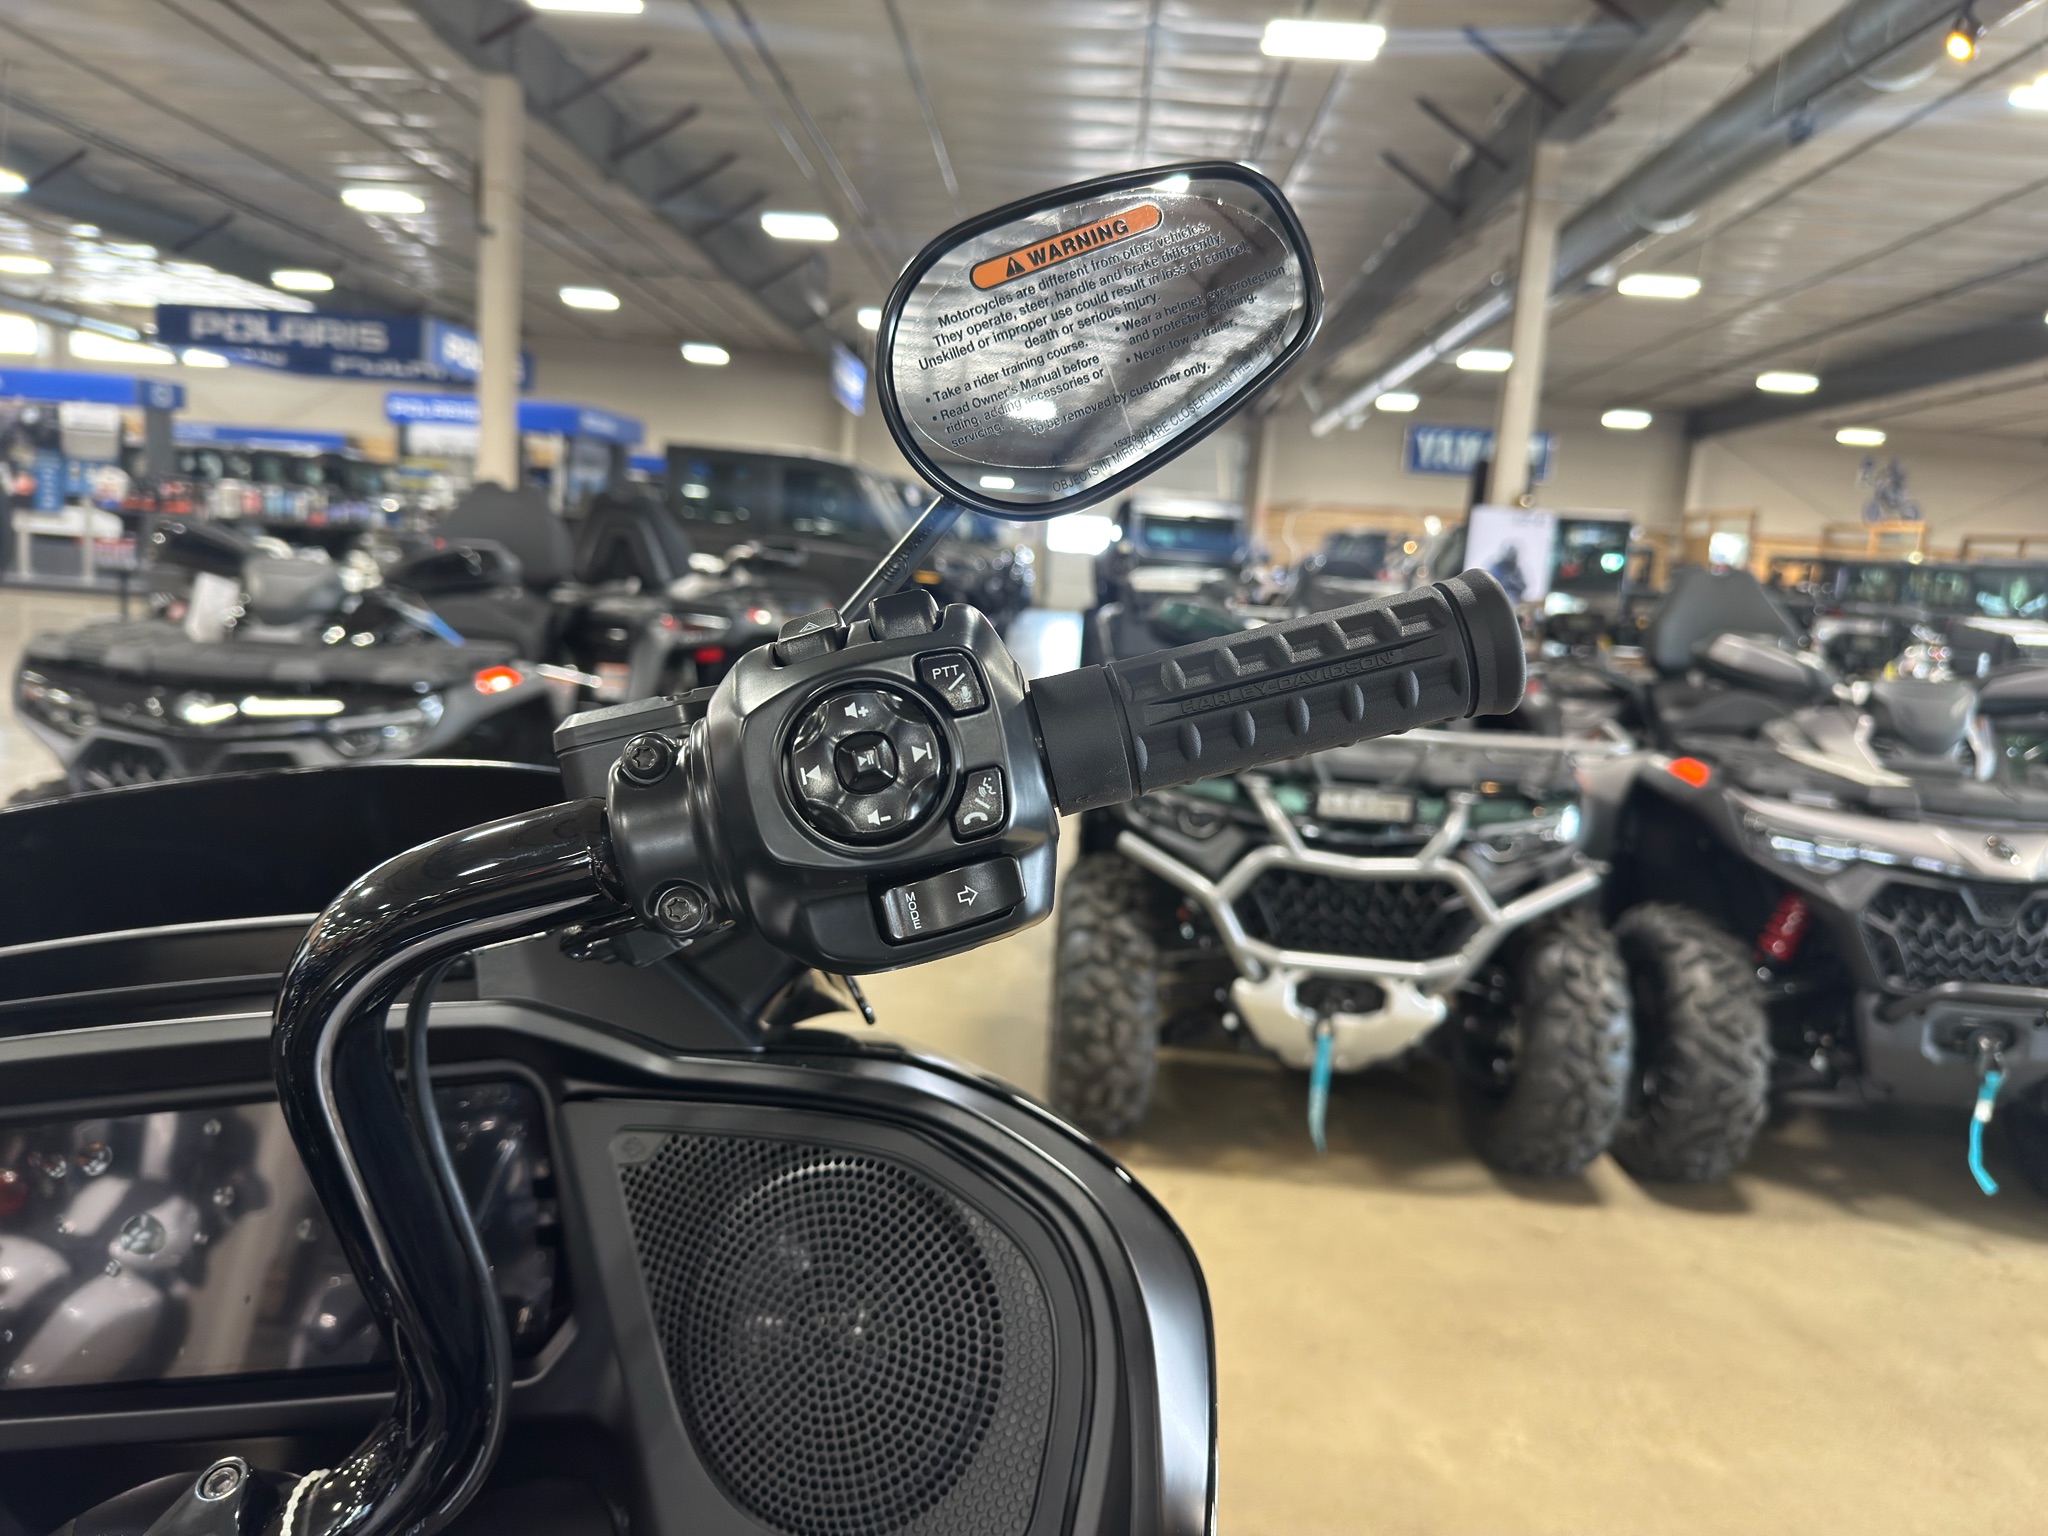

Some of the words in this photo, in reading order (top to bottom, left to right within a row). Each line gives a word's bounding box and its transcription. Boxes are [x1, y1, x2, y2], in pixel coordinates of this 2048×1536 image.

[1026, 219, 1129, 267] WARNING
[918, 338, 975, 371] Unskilled
[977, 337, 991, 350] or
[992, 314, 1048, 345] improper
[1051, 306, 1073, 321] use
[1075, 292, 1109, 312] could
[1111, 277, 1147, 297] result
[1149, 274, 1160, 286] in
[1161, 265, 1187, 282] loss
[1189, 257, 1201, 271] of
[1204, 241, 1250, 266] control.
[932, 328, 963, 348] They
[966, 310, 1017, 337] operate,
[1019, 300, 1055, 316] steer,
[1055, 279, 1096, 302] handle
[1099, 267, 1122, 286] and
[1124, 256, 1158, 277] brake
[1161, 233, 1225, 264] differently.
[937, 296, 1014, 328] Motorcycles
[1016, 285, 1036, 301] are
[1038, 264, 1090, 291] different
[1091, 254, 1120, 271] from
[1122, 241, 1154, 260] other
[1156, 222, 1211, 249] vehicles.
[1122, 313, 1152, 332] Wear
[1155, 310, 1162, 321] a
[1164, 296, 1206, 318] helmet,
[1207, 288, 1227, 302] eye
[1229, 265, 1285, 294] protection
[189, 310, 389, 352] POLARIS
[1024, 328, 1059, 350] death
[1061, 322, 1075, 335] or
[1077, 305, 1122, 329] serious
[1122, 292, 1161, 314] injury.
[1128, 329, 1150, 346] and
[1152, 309, 1207, 338] protective
[1209, 293, 1258, 316] clothing.
[1133, 344, 1167, 364] Never
[1168, 338, 1190, 350] tow
[1192, 331, 1200, 341] a
[1202, 318, 1238, 337] trailer.
[932, 384, 962, 403] Take
[964, 382, 972, 392] a
[973, 371, 1000, 388] rider
[1001, 355, 1045, 377] training
[1046, 339, 1088, 360] course.
[940, 401, 970, 422] Read
[972, 385, 1019, 408] Owner's
[1019, 367, 1062, 392] Manual
[1063, 355, 1100, 375] before
[946, 415, 982, 434] riding,
[983, 399, 1022, 422] adding
[1024, 374, 1090, 404] accessories
[1092, 367, 1105, 380] or
[1029, 421, 1044, 435] To
[1045, 417, 1061, 430] be
[1063, 395, 1112, 423] removed
[1112, 390, 1128, 405] by
[1129, 371, 1181, 398] customer
[1183, 361, 1211, 377] only.
[951, 422, 1005, 447] servicing.
[1052, 465, 1100, 493] OBJECTS
[1100, 457, 1111, 471] IN
[1112, 436, 1150, 465] MIRROR
[1152, 420, 1171, 440] ARE
[1169, 396, 1208, 426] CLOSER
[1208, 377, 1234, 402] THAN
[1254, 323, 1285, 358] APPEAR
[932, 663, 959, 679] PTT
[1181, 652, 1391, 713] HARLEY-DAVIDSON
[905, 892, 922, 930] MODE
